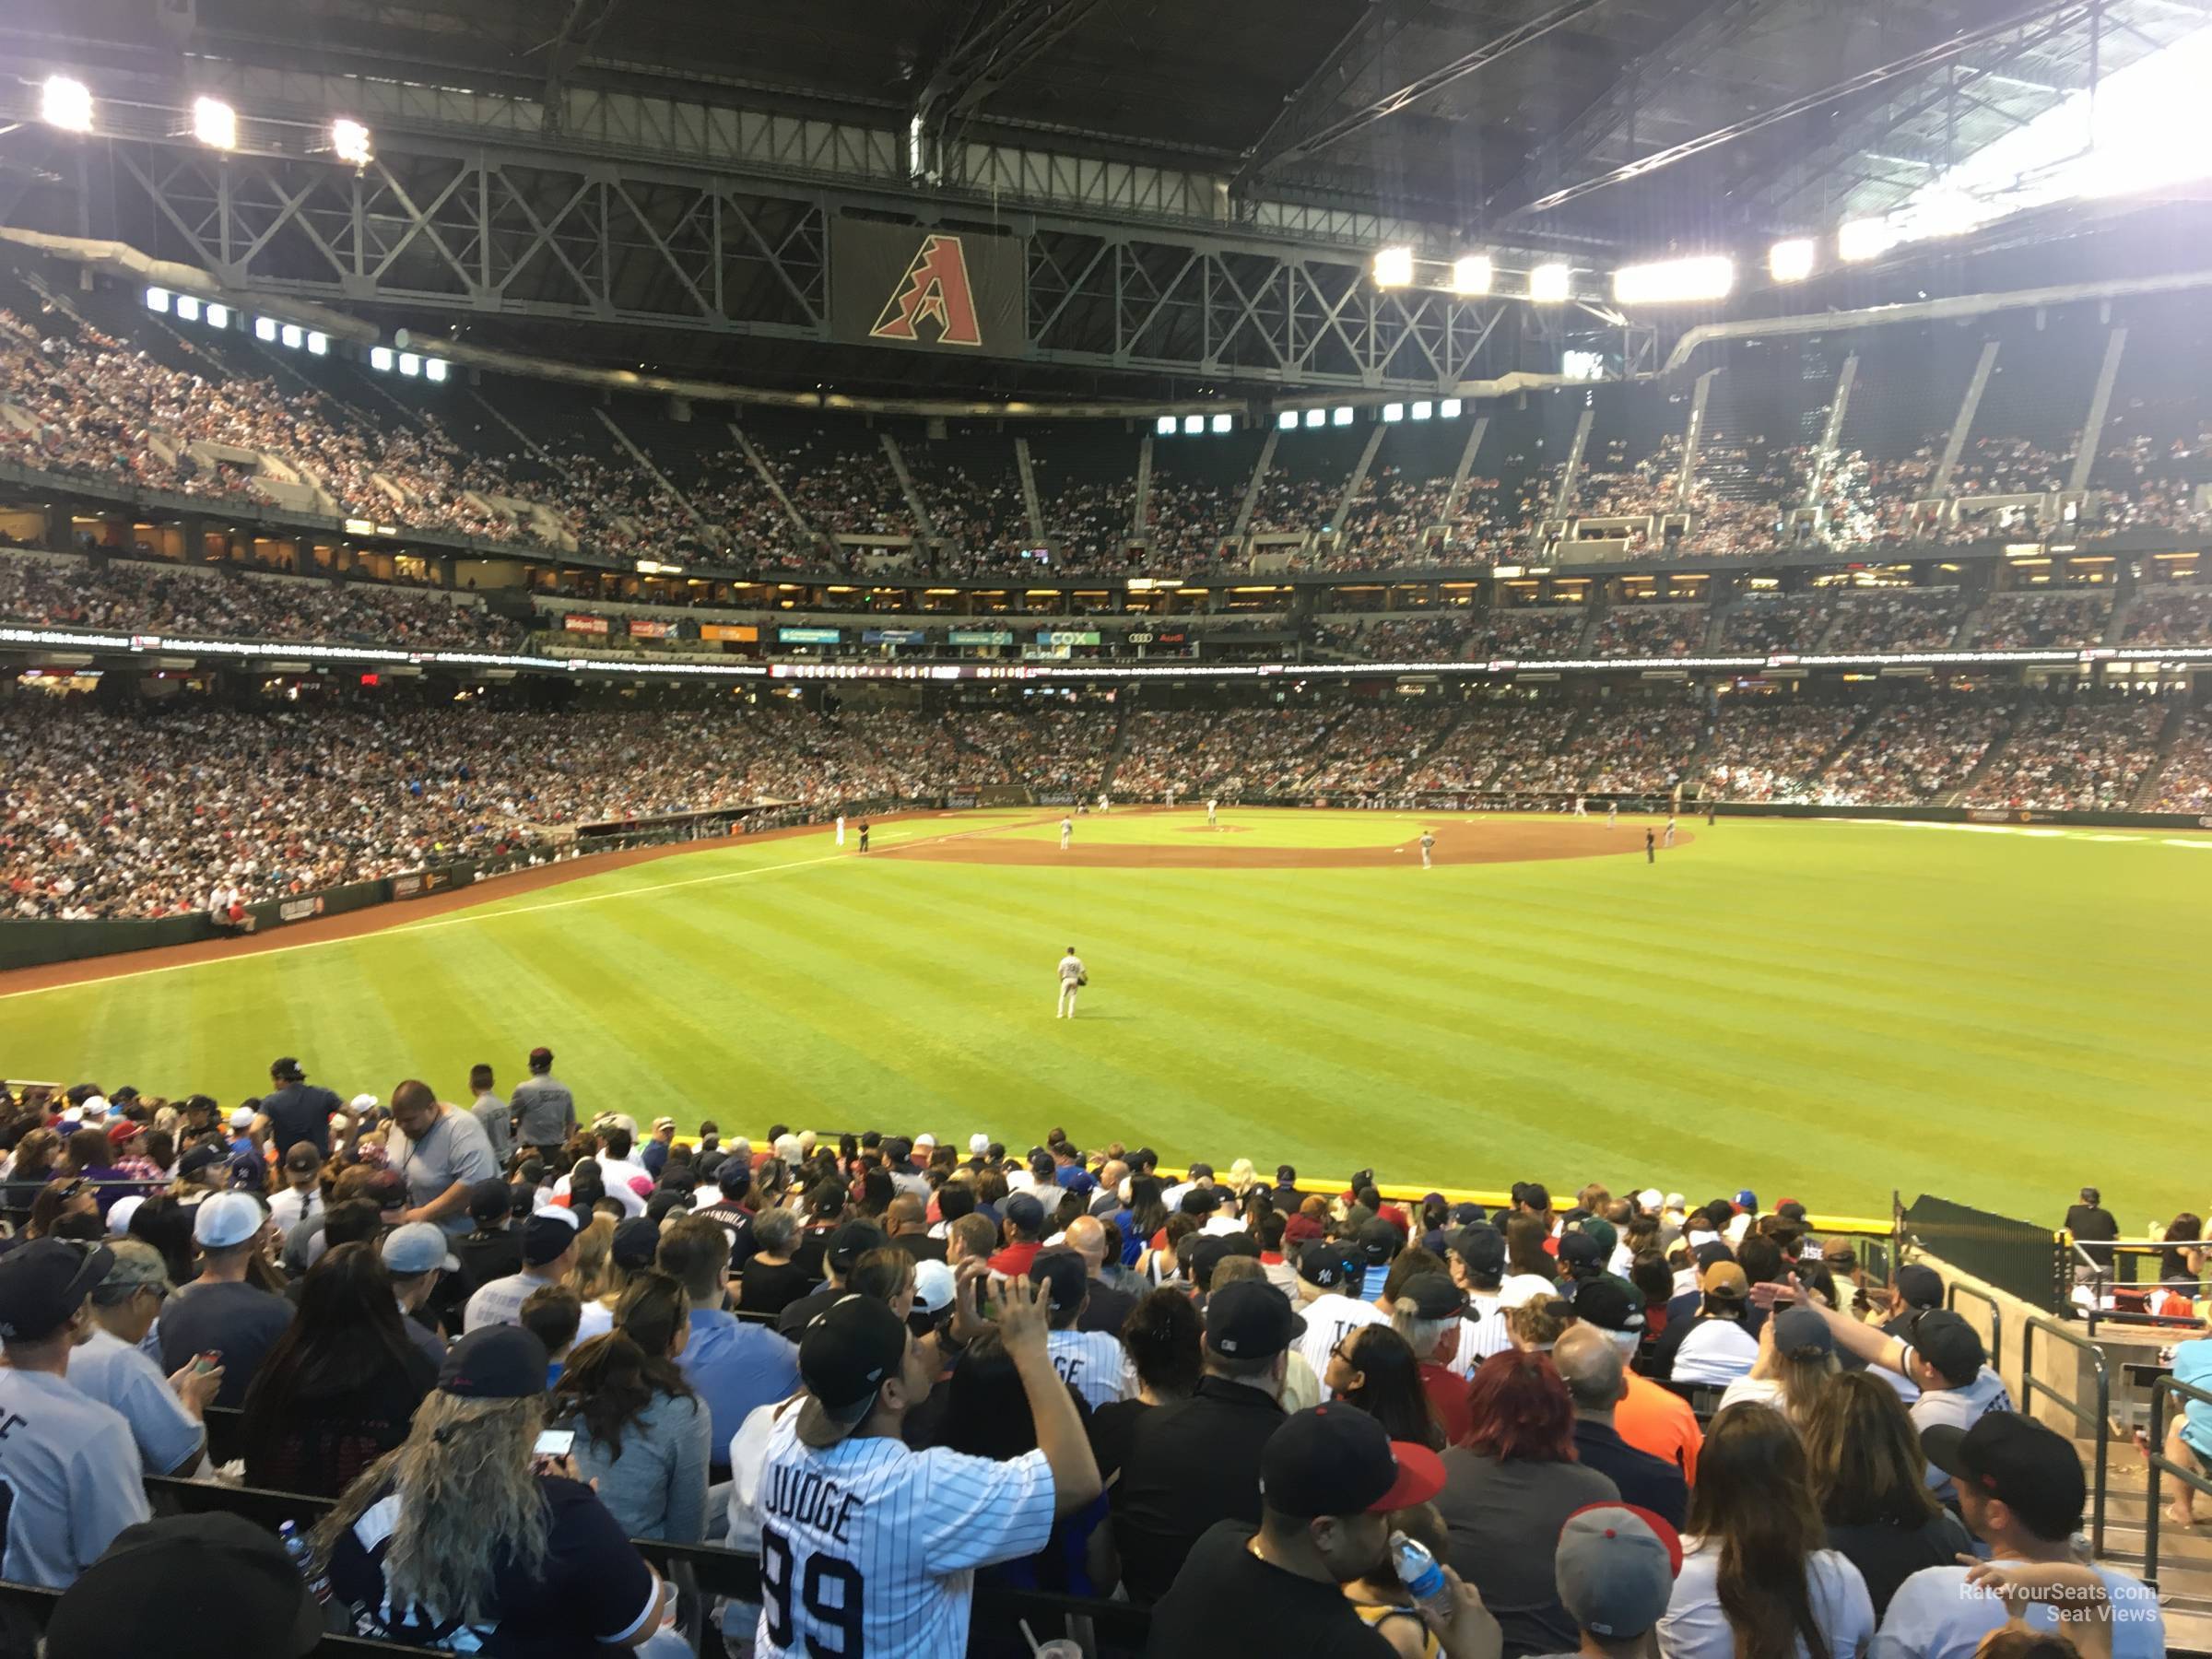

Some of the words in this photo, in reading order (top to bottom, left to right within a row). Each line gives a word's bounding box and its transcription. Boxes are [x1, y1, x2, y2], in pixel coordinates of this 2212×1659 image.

[869, 234, 982, 346] A
[1050, 632, 1088, 645] COX
[1159, 633, 1184, 642] Audi
[700, 1209, 747, 1230] ENZUELA
[765, 1465, 865, 1545] JUDGE
[759, 1523, 865, 1659] 99
